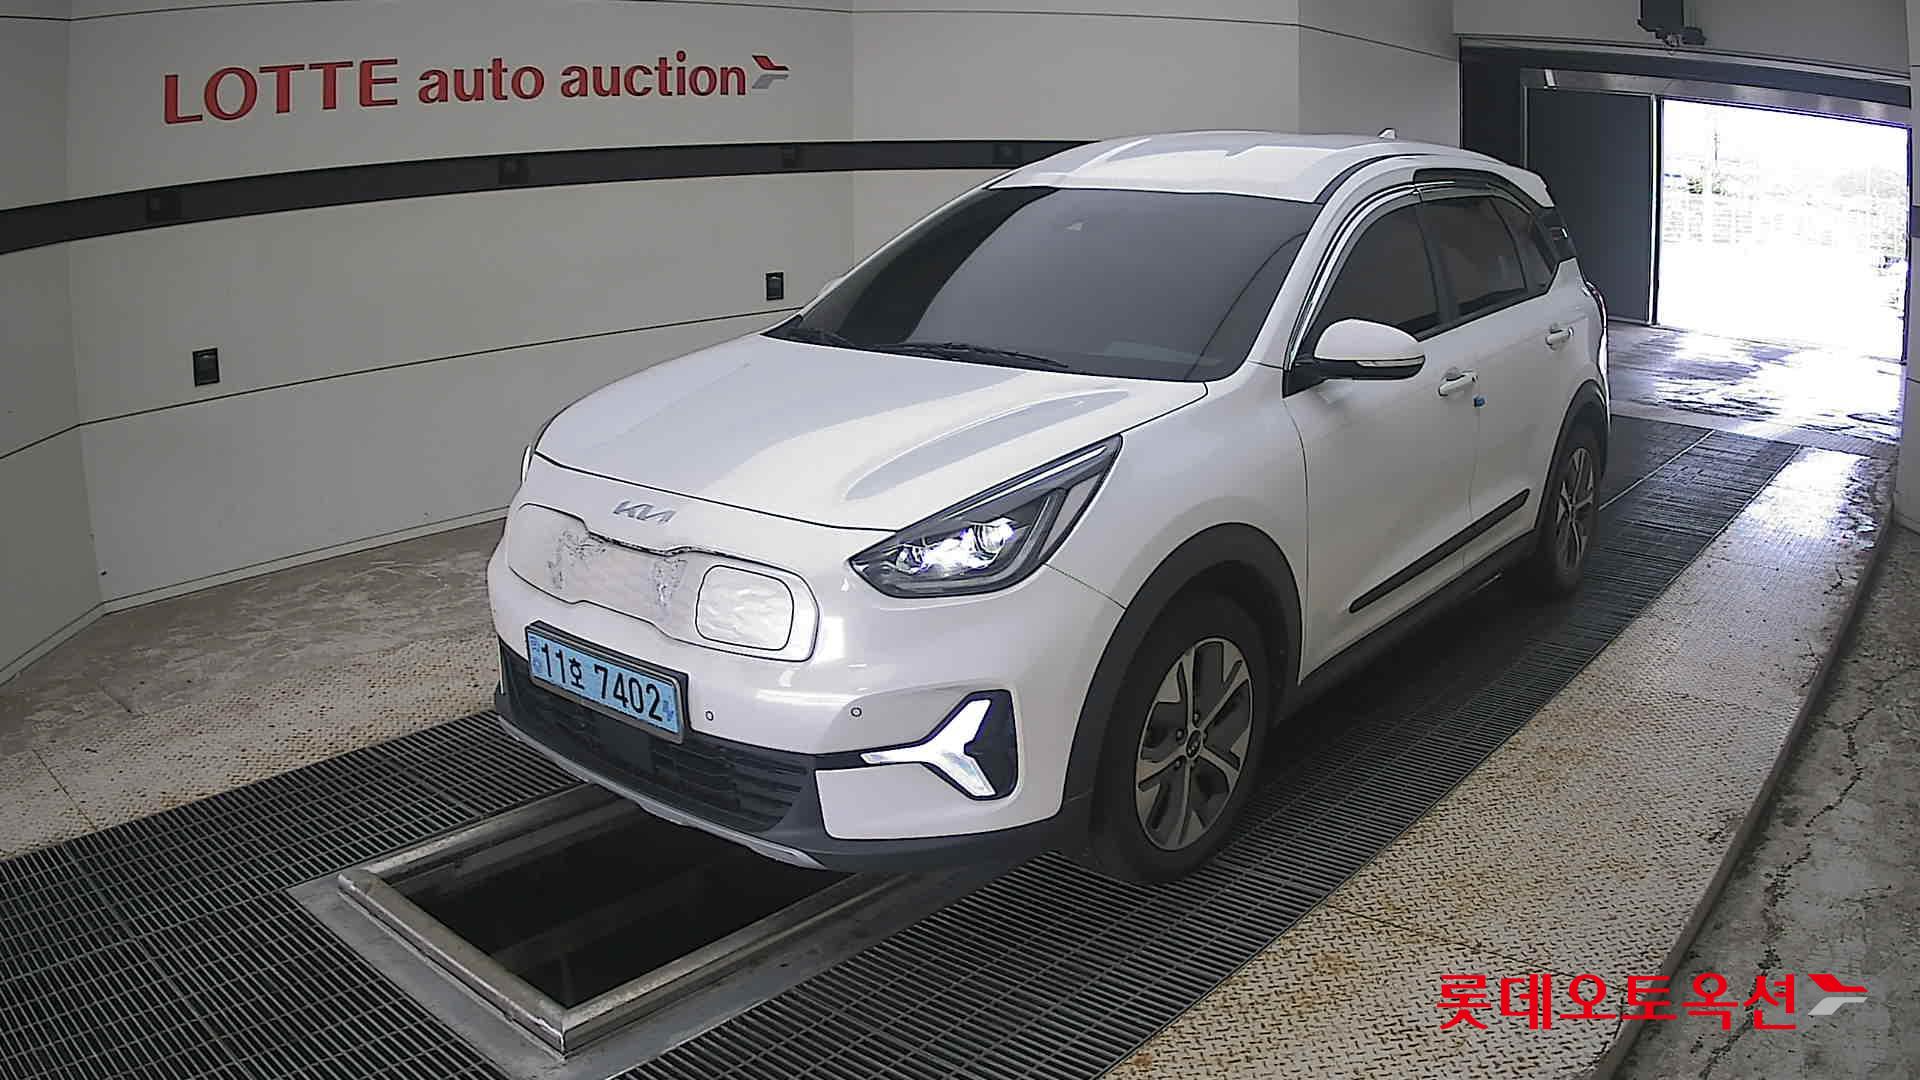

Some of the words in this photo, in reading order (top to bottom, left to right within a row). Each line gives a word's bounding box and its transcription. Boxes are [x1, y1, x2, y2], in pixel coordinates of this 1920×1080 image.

[163, 58, 398, 125] LOTTE
[417, 57, 546, 104] auto
[560, 50, 747, 98] auction
[593, 664, 664, 723] 7402
